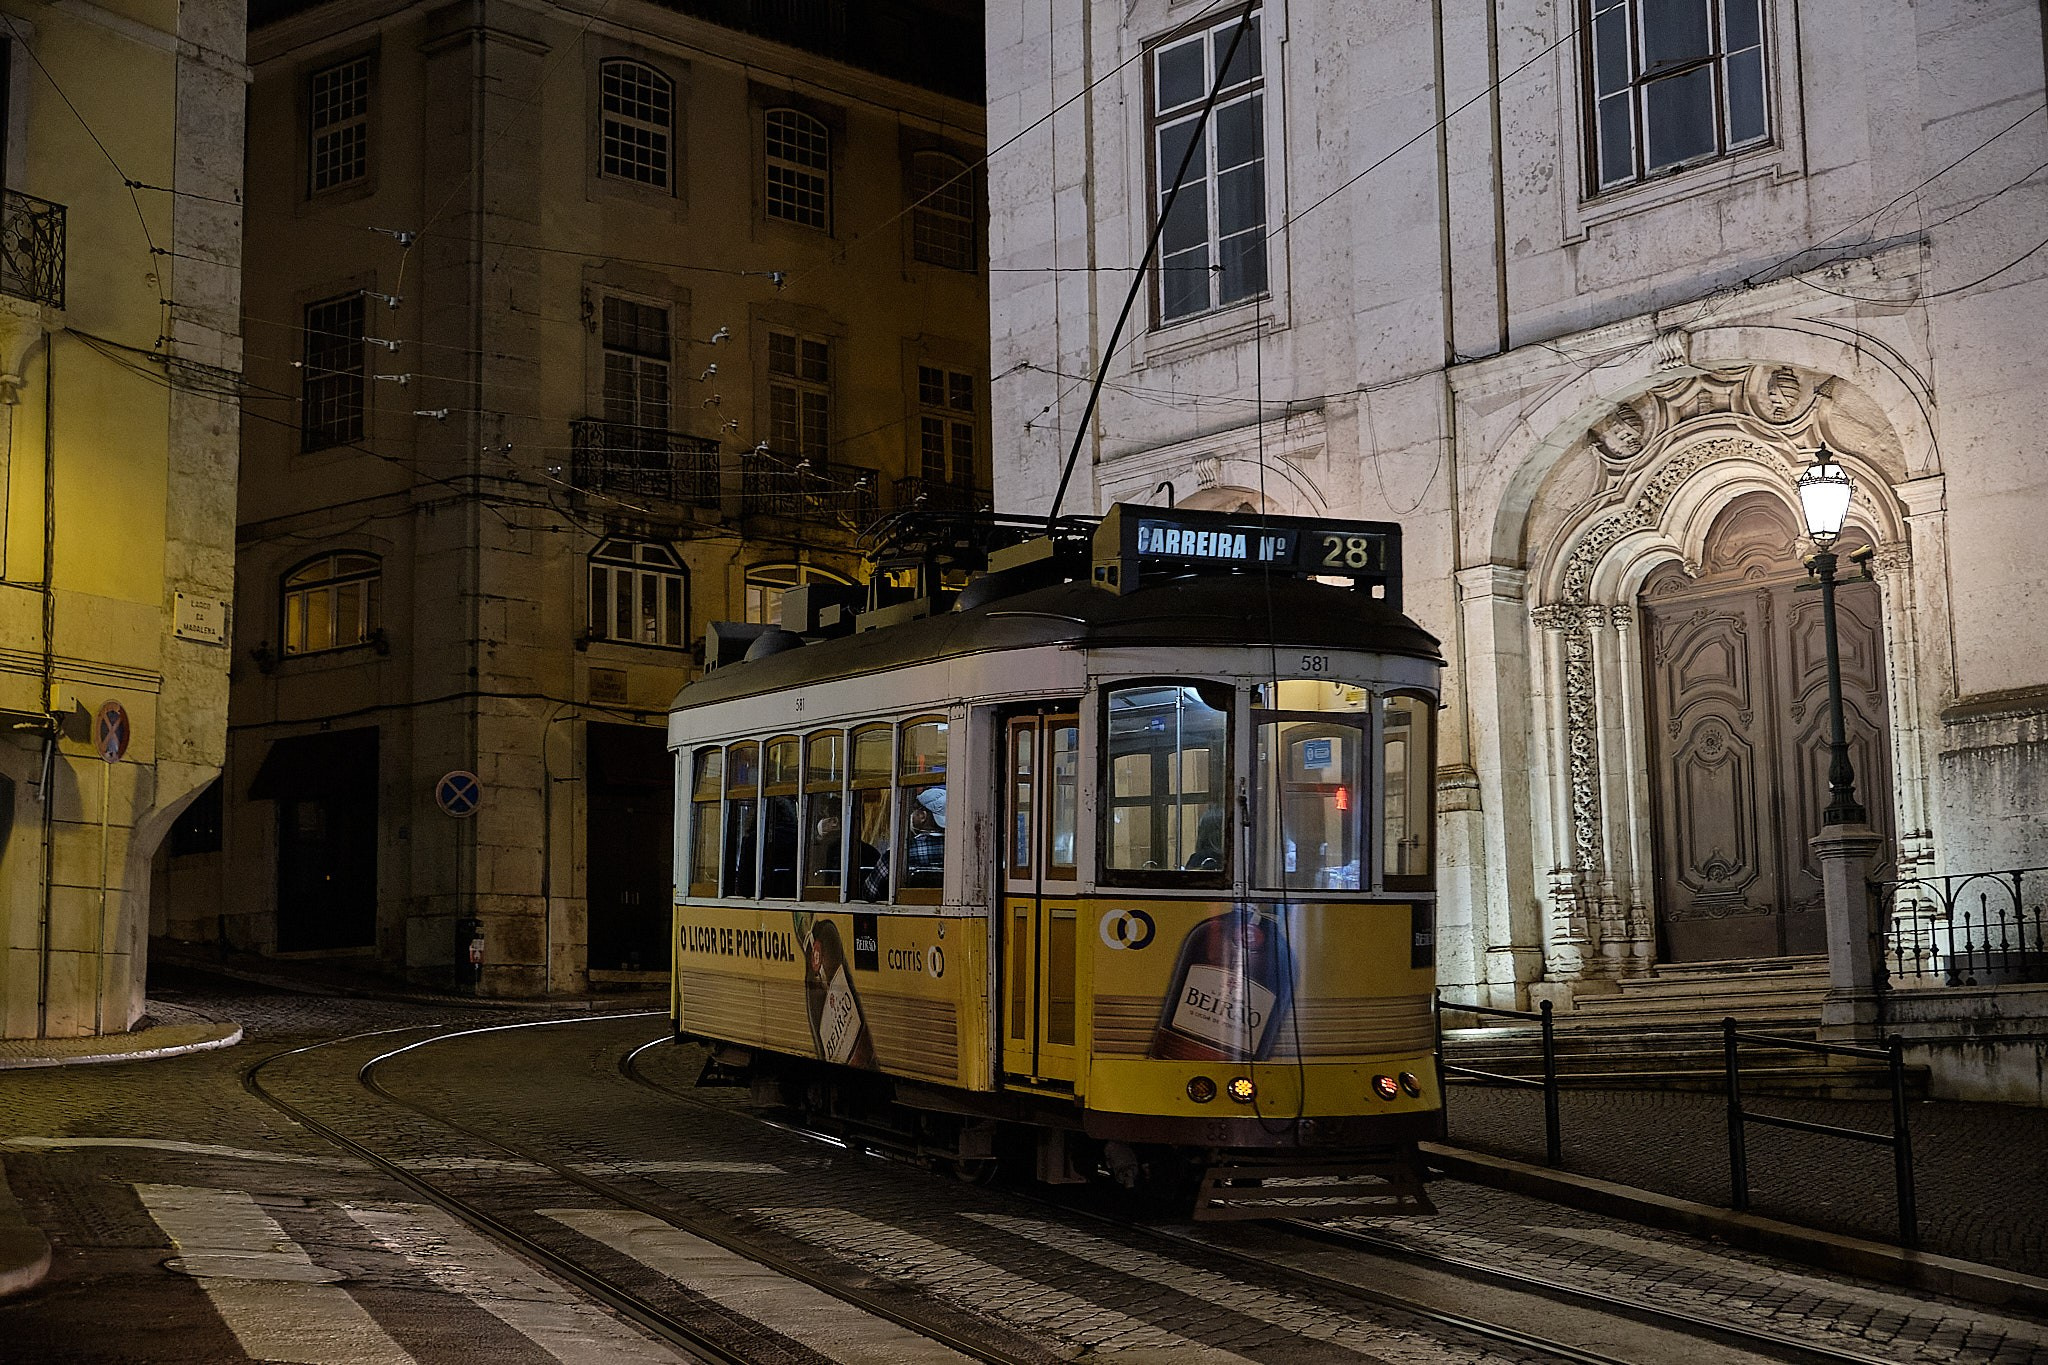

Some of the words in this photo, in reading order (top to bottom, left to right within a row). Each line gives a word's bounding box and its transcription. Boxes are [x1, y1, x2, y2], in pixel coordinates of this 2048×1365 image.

[1138, 527, 1247, 559] CARREIRA
[1322, 535, 1368, 569] 28
[190, 600, 211, 610] LARGO
[196, 613, 204, 621] DA
[183, 623, 216, 635] MADALENA
[1301, 655, 1329, 671] 581
[795, 697, 805, 712] 581
[680, 925, 687, 951] O
[689, 925, 718, 954] LICOR
[720, 928, 733, 956] DE
[736, 929, 795, 962] PORTUGAL
[888, 942, 922, 972] carris
